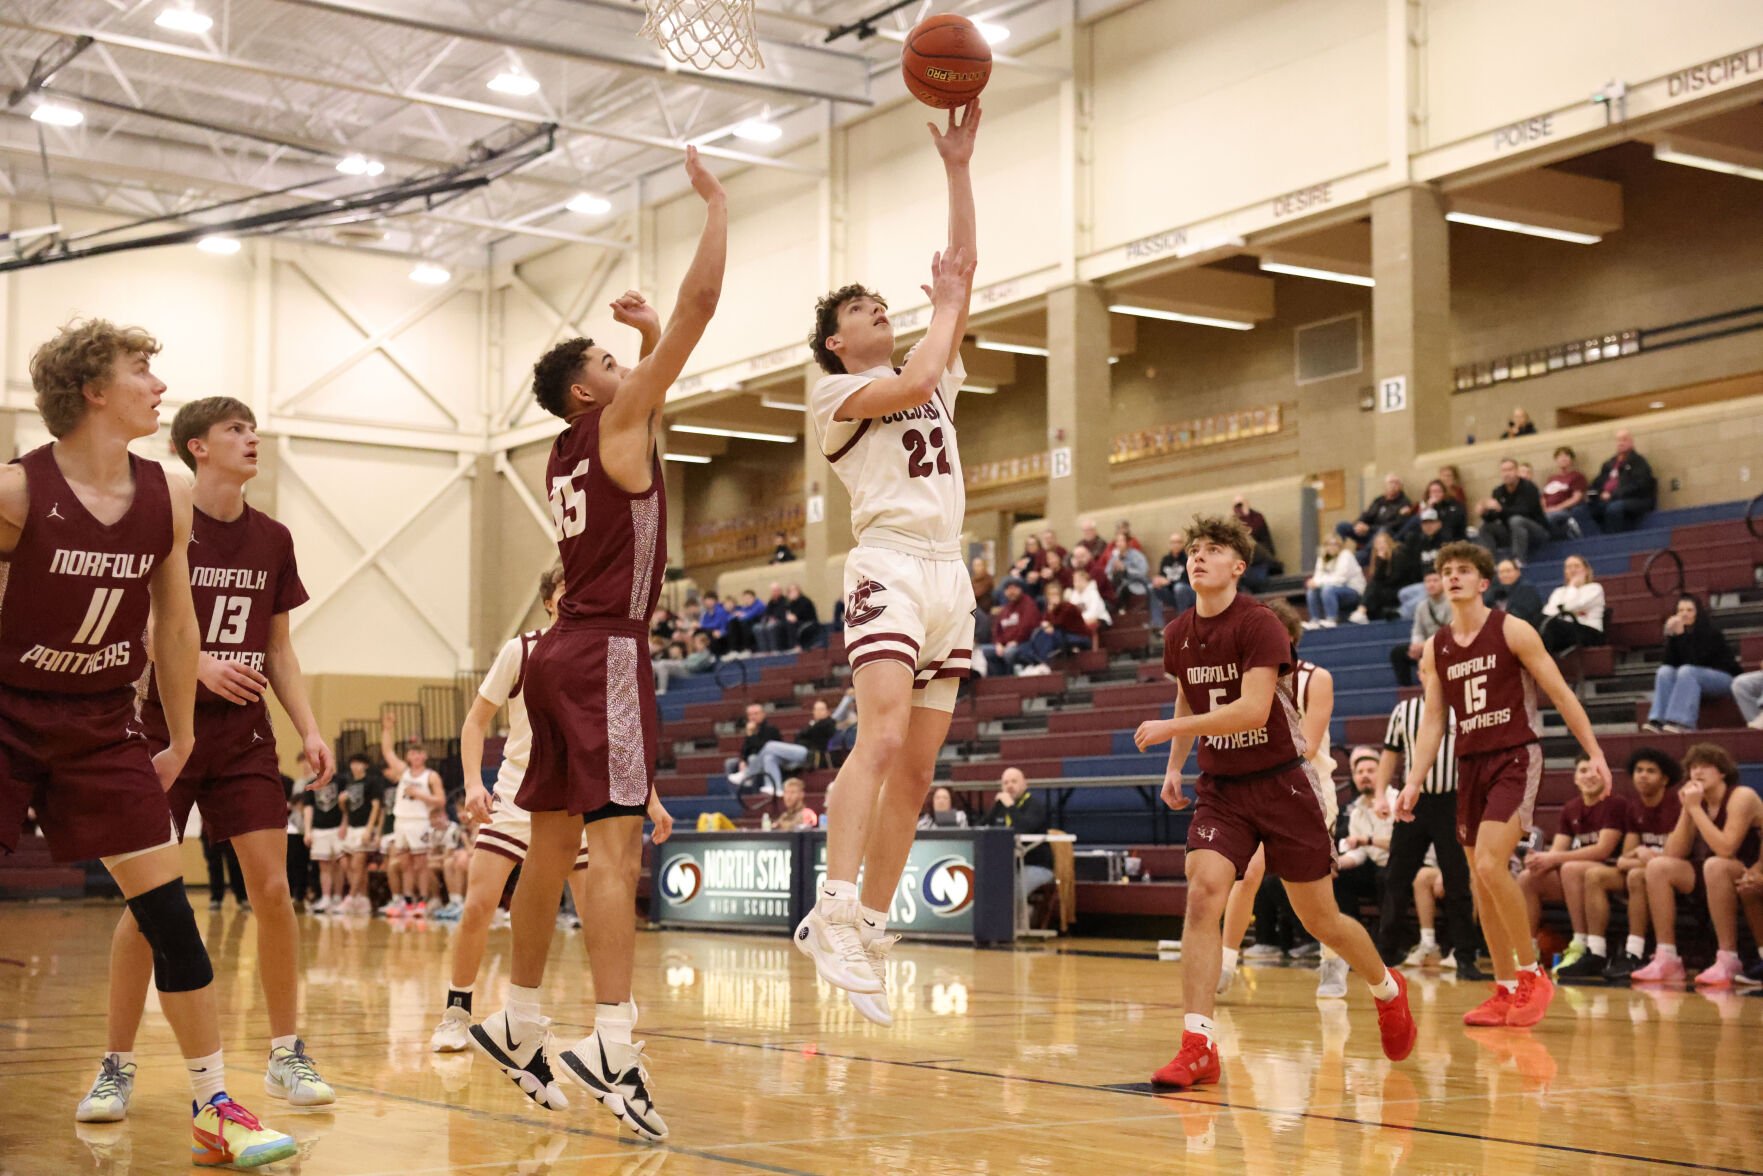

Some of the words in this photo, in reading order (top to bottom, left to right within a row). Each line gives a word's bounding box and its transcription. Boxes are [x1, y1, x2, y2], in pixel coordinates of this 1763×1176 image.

[926, 67, 948, 80] PRO
[1493, 114, 1554, 150] POISE
[1272, 184, 1332, 218] DESIRE
[1126, 227, 1188, 261] PASSION
[1384, 382, 1402, 409] B
[901, 426, 951, 479] 22
[49, 548, 155, 579] NORFOLK
[190, 566, 268, 590] NORFOLK
[71, 587, 125, 645] 11
[205, 595, 253, 644] 13
[20, 640, 131, 675] PANTHERS
[1446, 654, 1497, 681] NORFOLK
[1463, 674, 1488, 714] 15
[703, 849, 755, 890] NORTH
[709, 899, 740, 916] HIGH
[743, 899, 790, 916] SCHOOL
